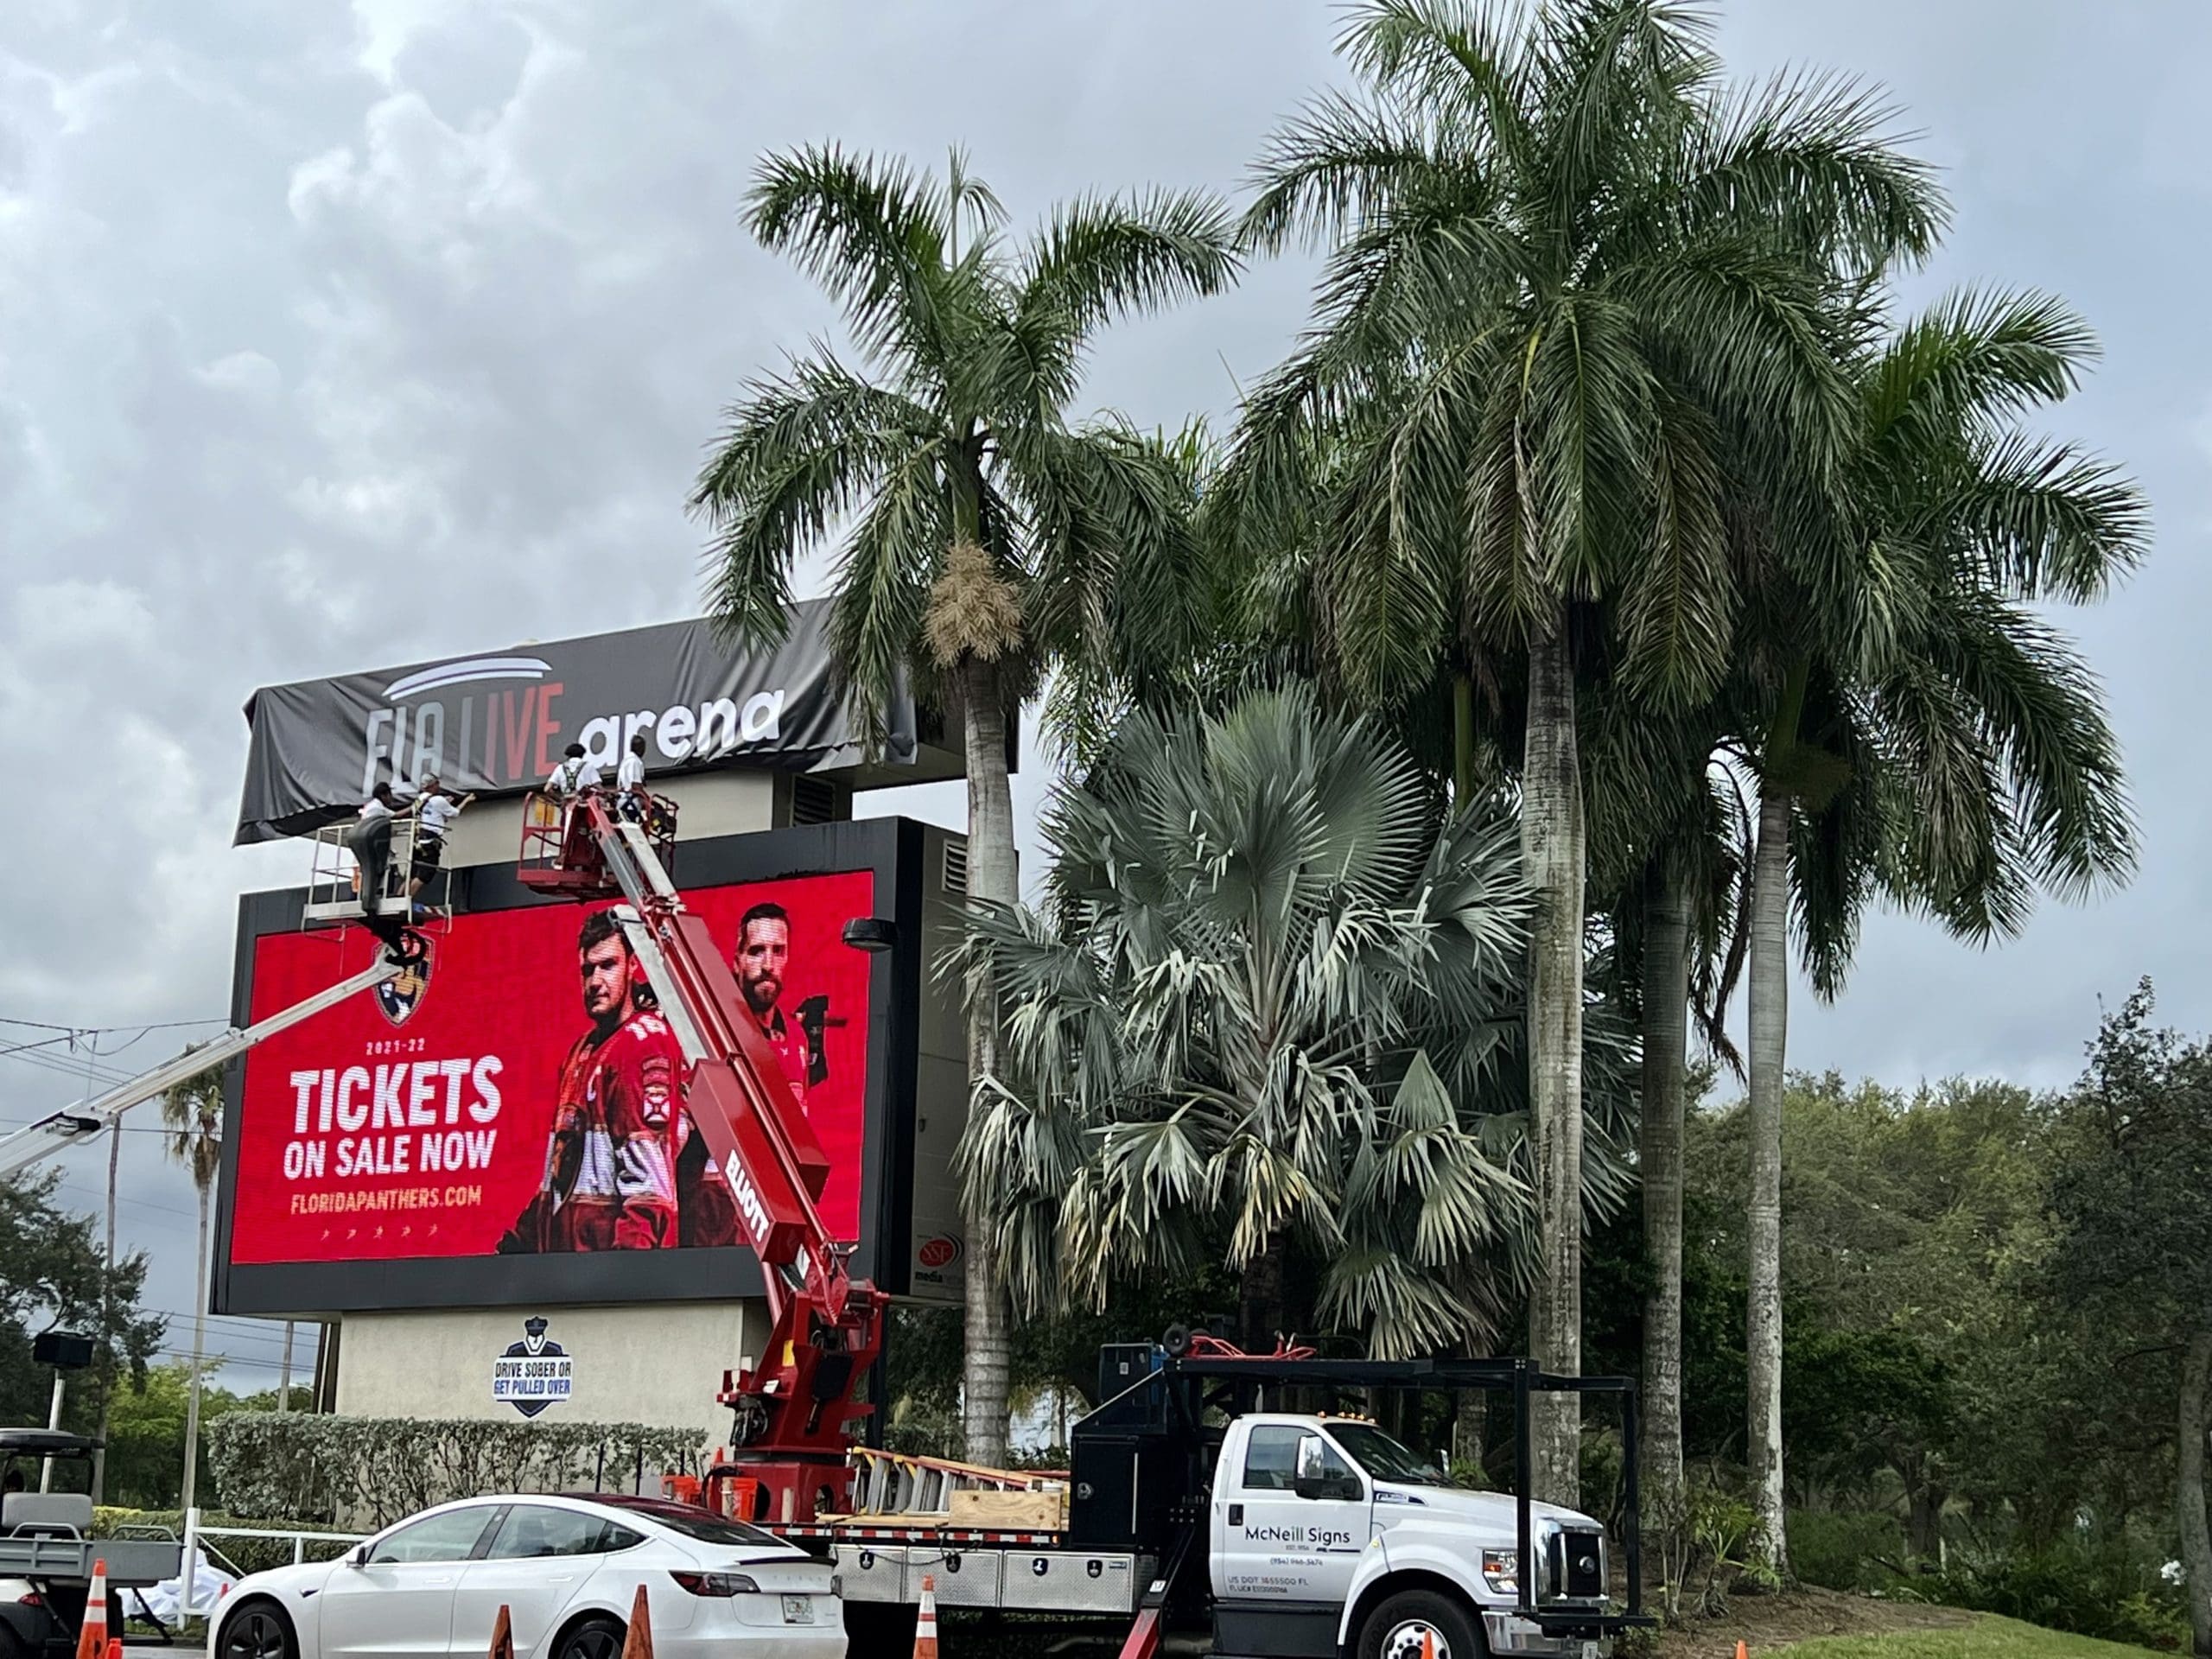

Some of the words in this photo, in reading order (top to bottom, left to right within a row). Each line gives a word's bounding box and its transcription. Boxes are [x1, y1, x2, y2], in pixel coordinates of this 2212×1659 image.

[457, 683, 563, 791] LIVE
[578, 690, 785, 769] arena
[365, 1037, 426, 1056] 2021-22
[289, 1054, 504, 1134] TICKETS
[283, 1140, 327, 1180] ON
[334, 1134, 411, 1177] SALE
[419, 1128, 498, 1172] NOW
[290, 1185, 482, 1215] FLORIDAPANTHERS.COM
[725, 1148, 770, 1243] ELLIOTT
[495, 1363, 523, 1378] DRIVE
[524, 1362, 556, 1377] SOBER
[558, 1362, 571, 1376] OR
[493, 1380, 510, 1395] GET
[512, 1380, 545, 1395] PULLED
[547, 1379, 571, 1394] OVER
[1245, 1526, 1304, 1542] McNeill
[1308, 1528, 1351, 1546] Signs
